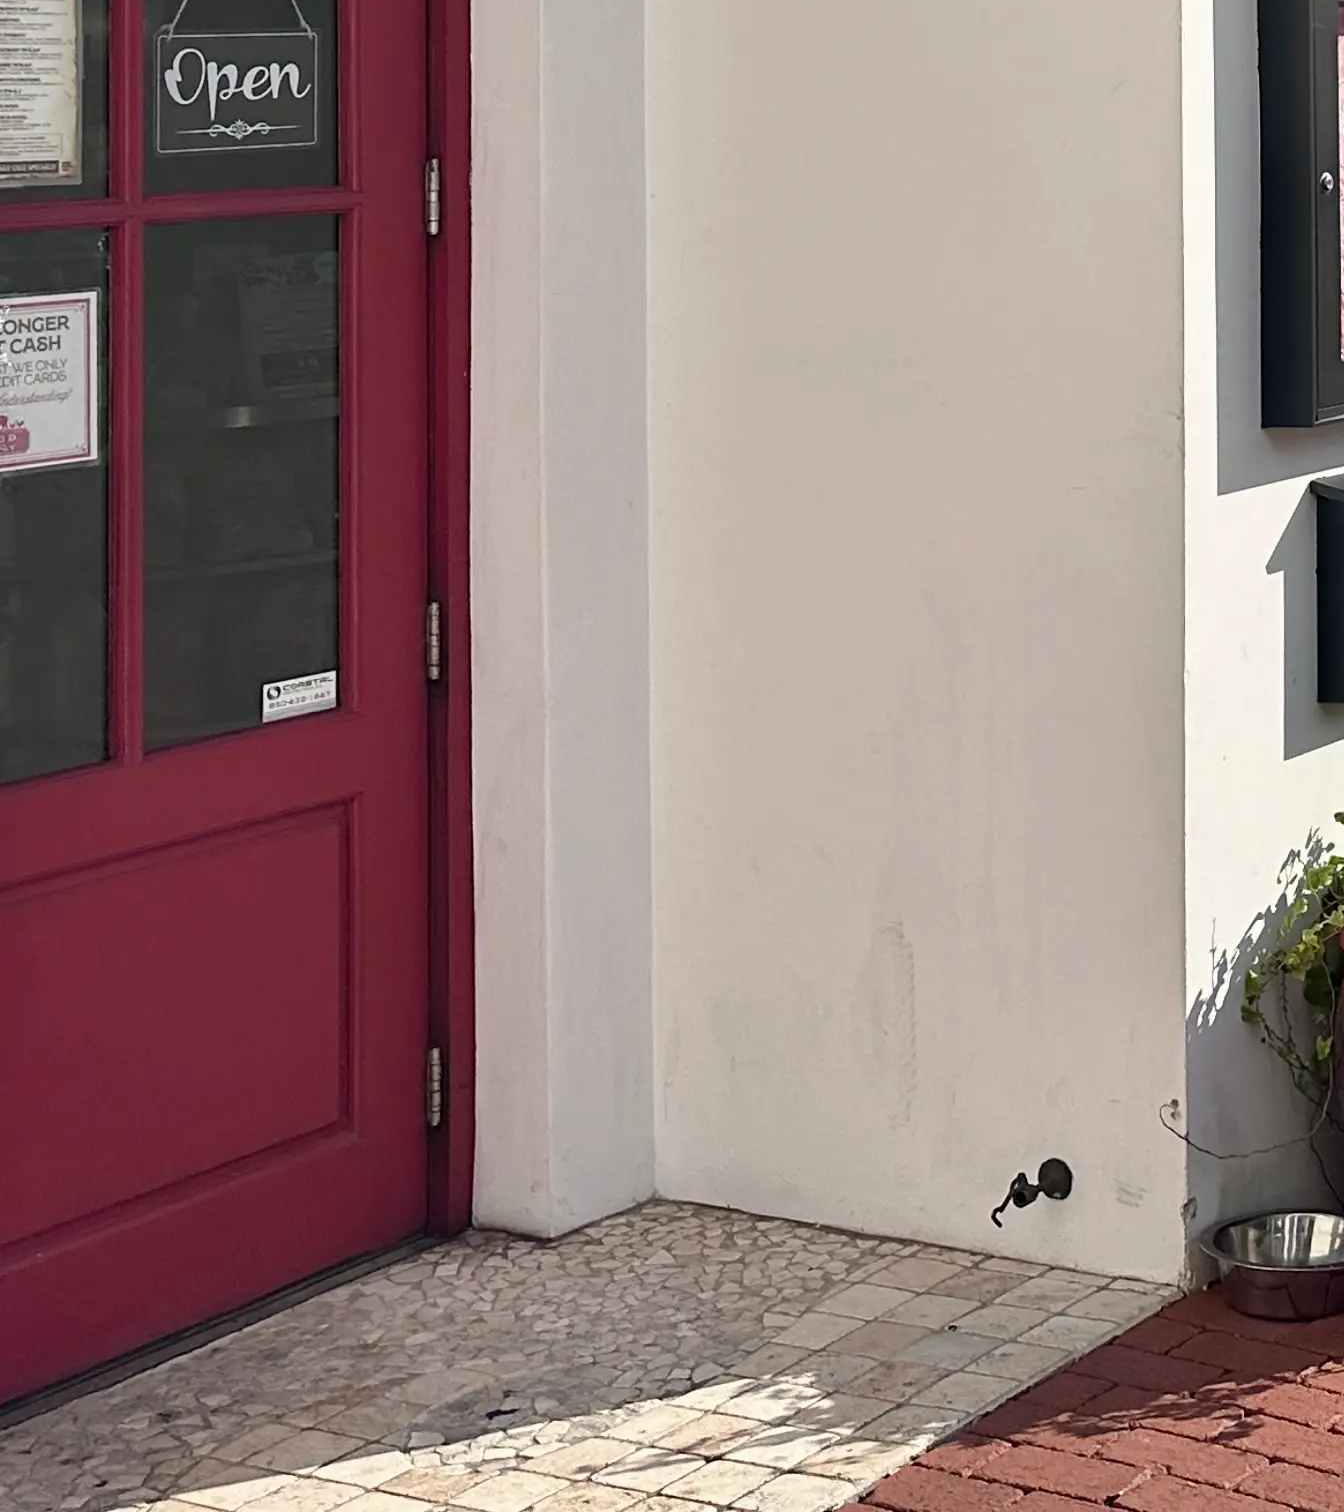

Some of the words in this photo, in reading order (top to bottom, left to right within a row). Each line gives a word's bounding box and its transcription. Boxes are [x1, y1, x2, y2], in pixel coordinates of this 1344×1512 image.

[165, 47, 311, 121] Open
[0, 315, 70, 335] ONGER
[10, 335, 61, 353] CASH
[35, 358, 68, 370] ONLY
[24, 371, 67, 385] CARDS
